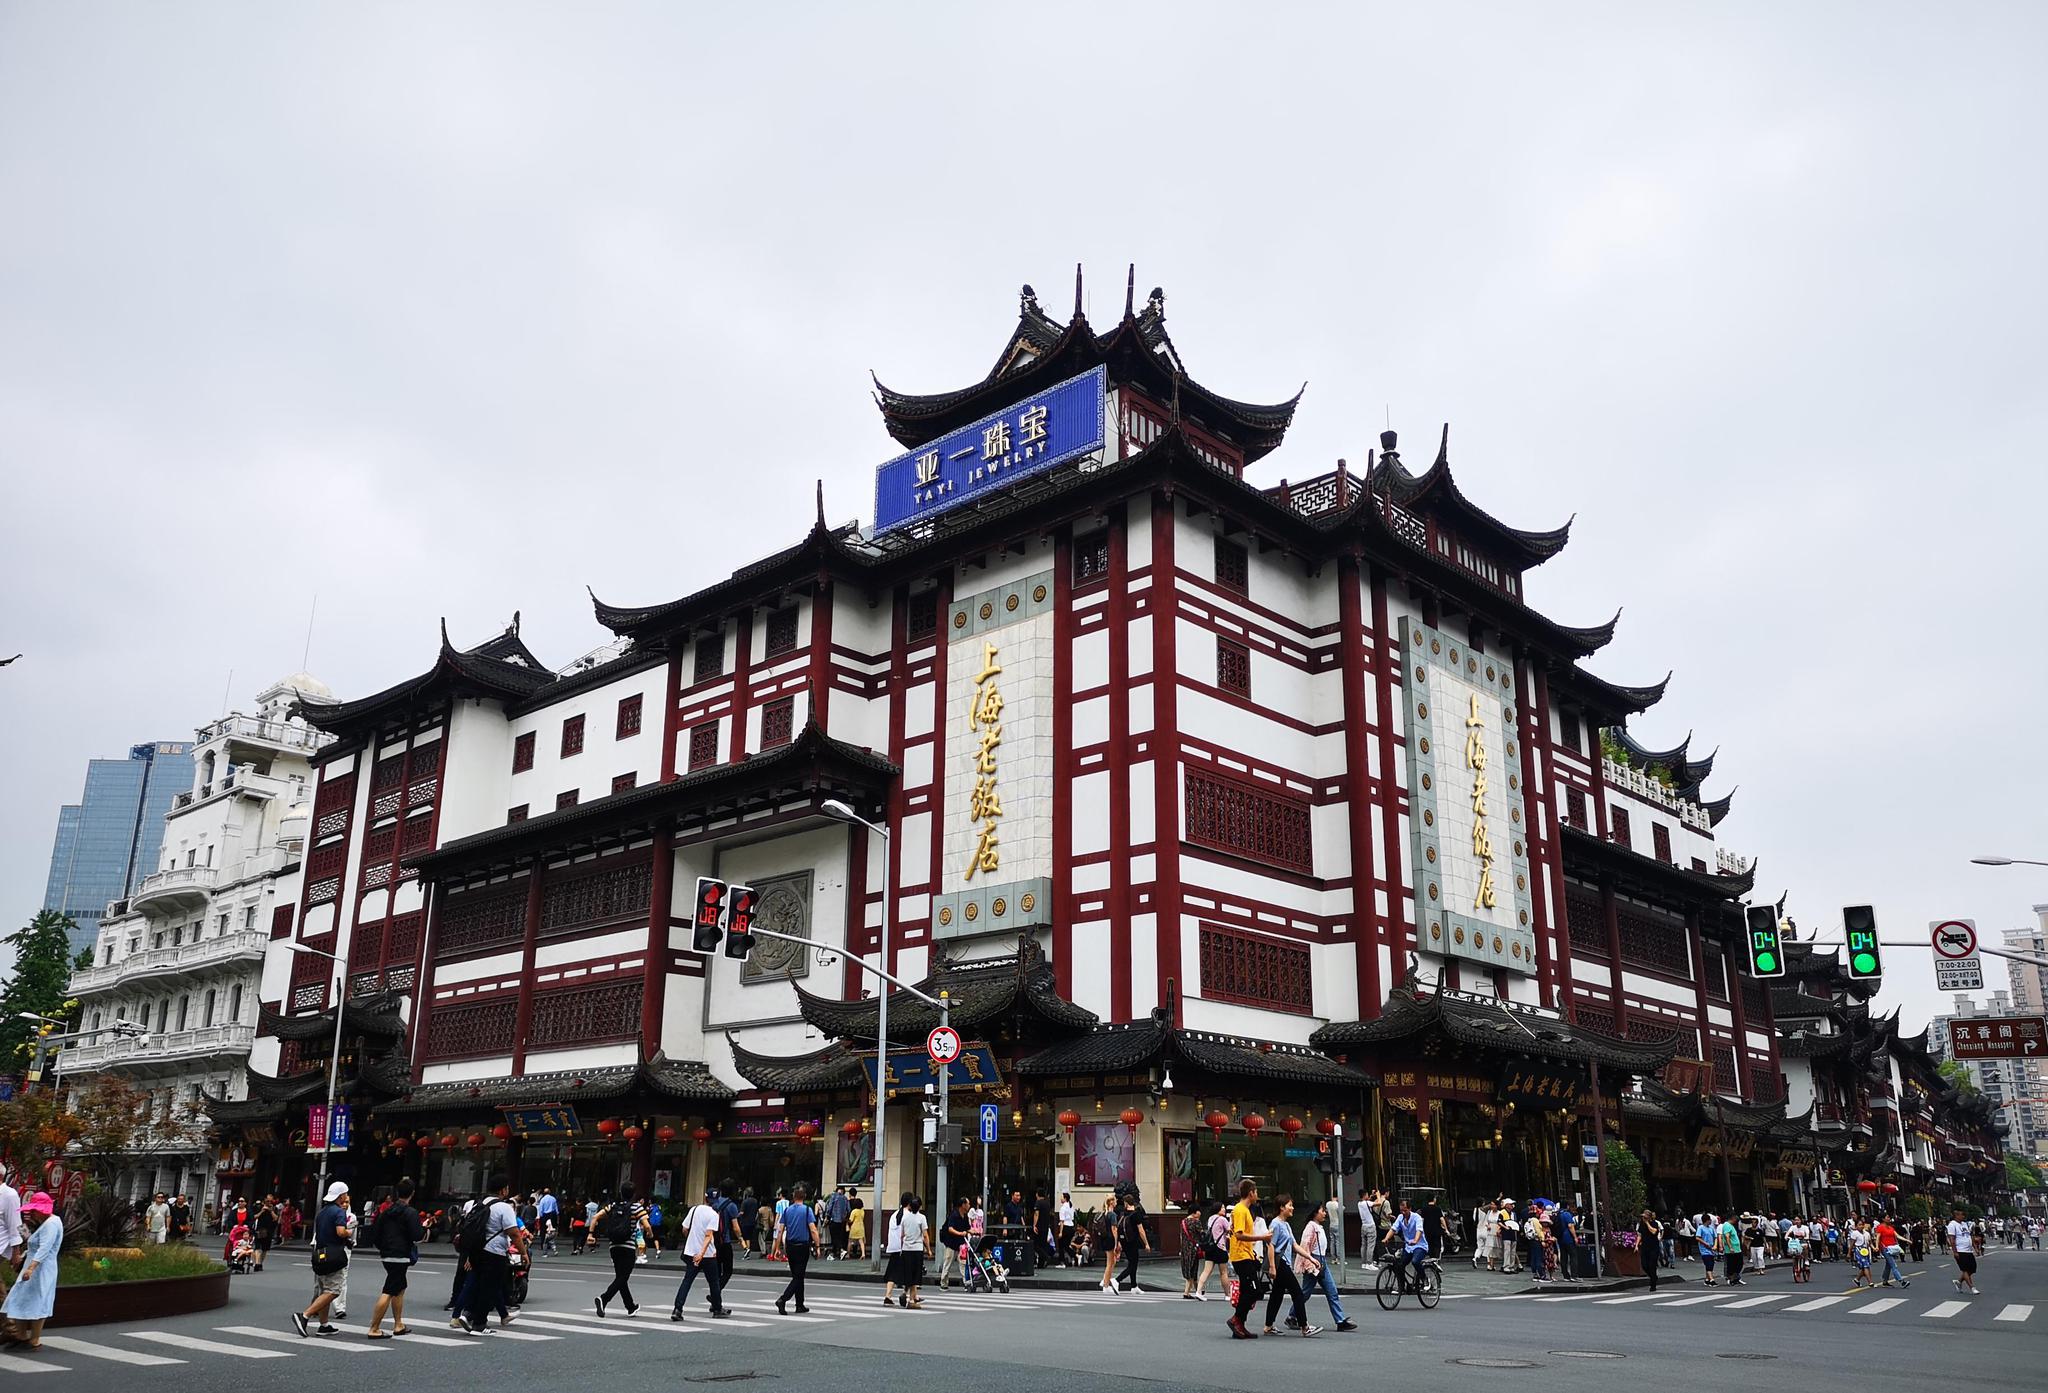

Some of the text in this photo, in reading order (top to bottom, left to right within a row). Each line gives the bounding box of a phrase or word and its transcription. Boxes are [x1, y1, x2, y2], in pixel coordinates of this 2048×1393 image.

[913, 405, 1047, 488] 亚一珠宝
[913, 440, 1047, 504] YAYI JEWELRY
[1753, 932, 1775, 949] 04
[1850, 932, 1874, 950] 04
[1956, 1025, 2013, 1039] 沉香阁
[934, 1037, 955, 1051] 3.5m
